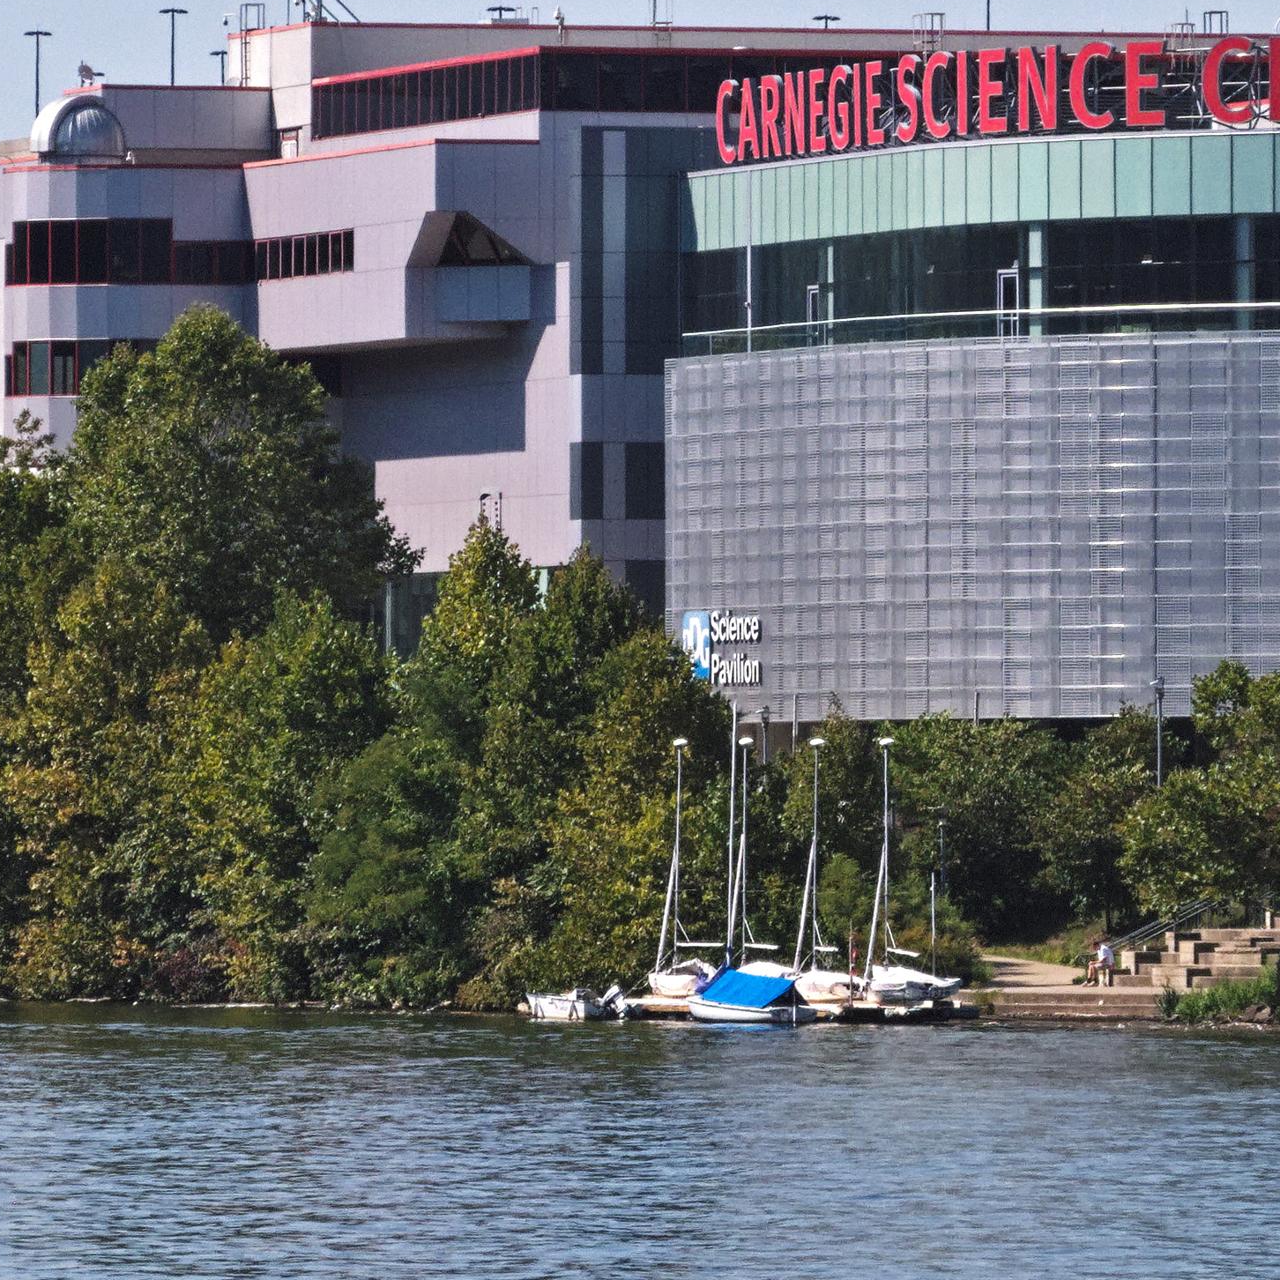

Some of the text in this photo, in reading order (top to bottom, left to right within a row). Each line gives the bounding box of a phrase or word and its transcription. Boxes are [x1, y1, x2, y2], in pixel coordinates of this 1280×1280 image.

[715, 59, 885, 165] CARNEGIE
[895, 40, 1166, 142] SCIENCE
[710, 610, 760, 641] Science
[710, 652, 760, 684] Pavilion
